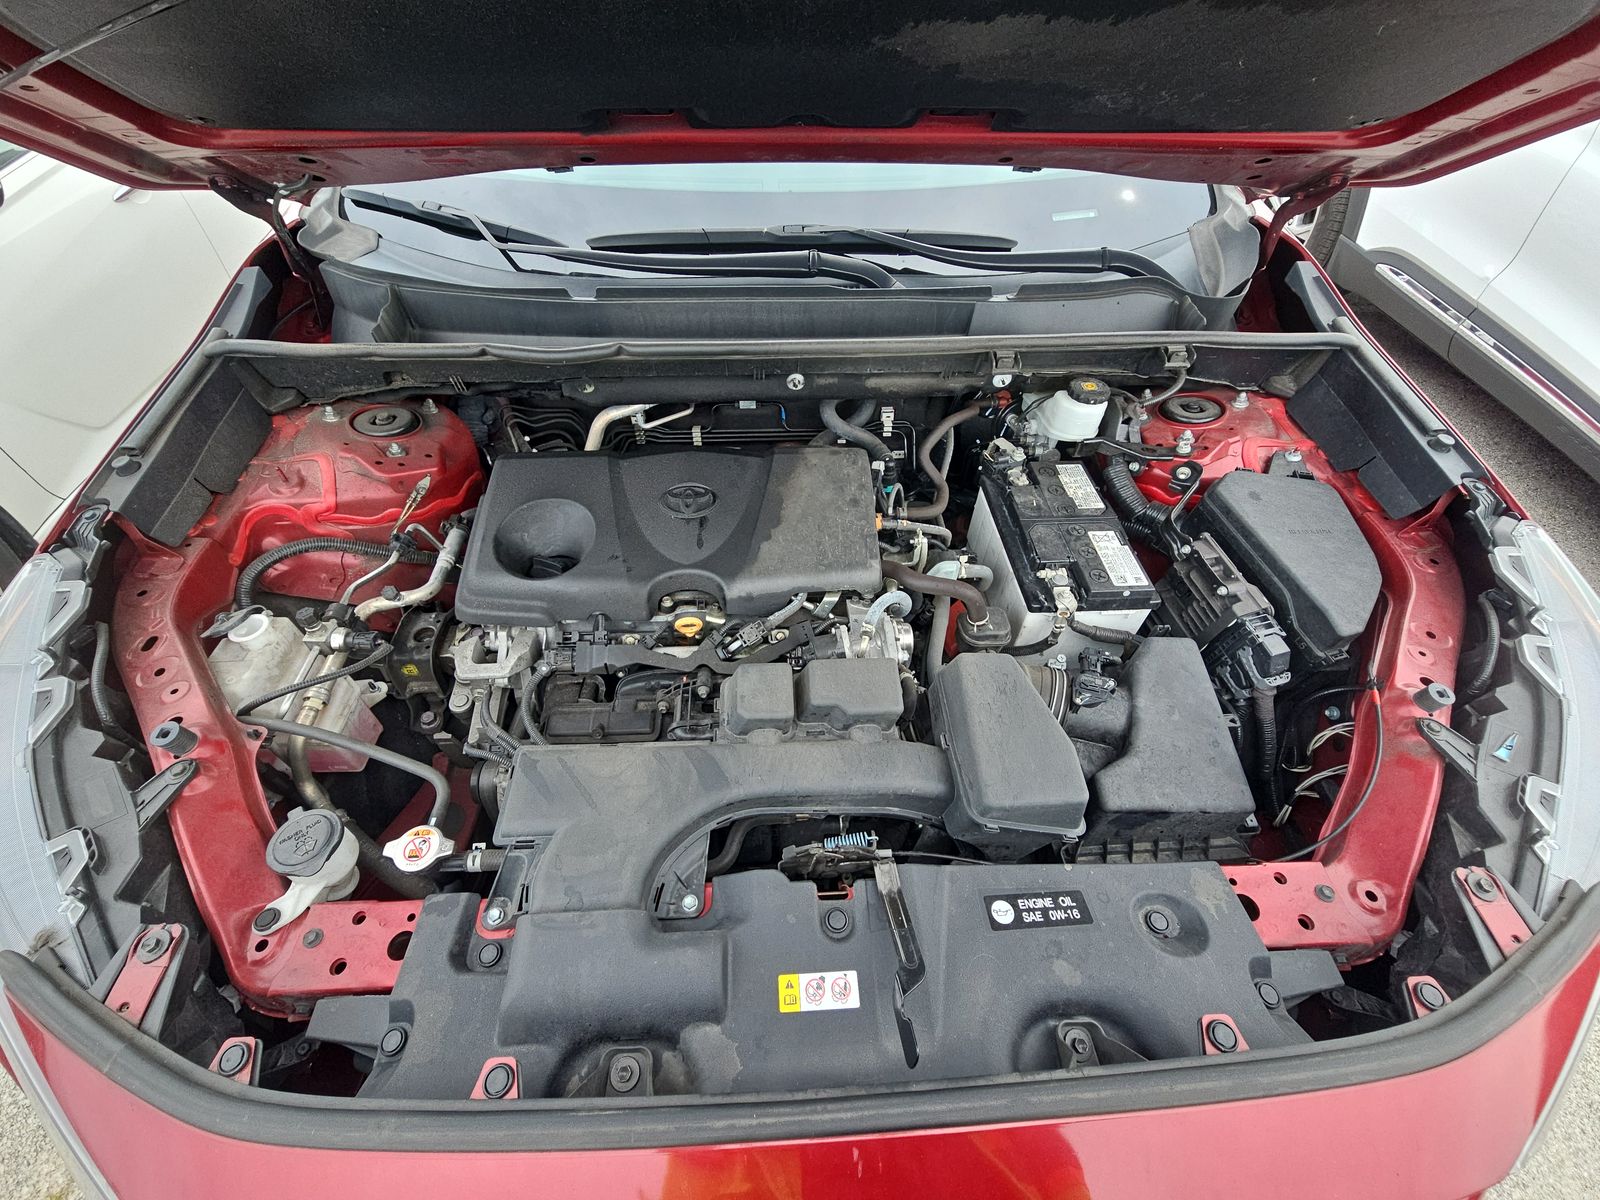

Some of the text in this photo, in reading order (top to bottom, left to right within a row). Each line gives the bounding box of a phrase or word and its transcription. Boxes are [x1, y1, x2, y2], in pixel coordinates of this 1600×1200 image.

[1017, 896, 1076, 909] ENGINE OIL
[1022, 909, 1080, 922] SAE 0W-16
